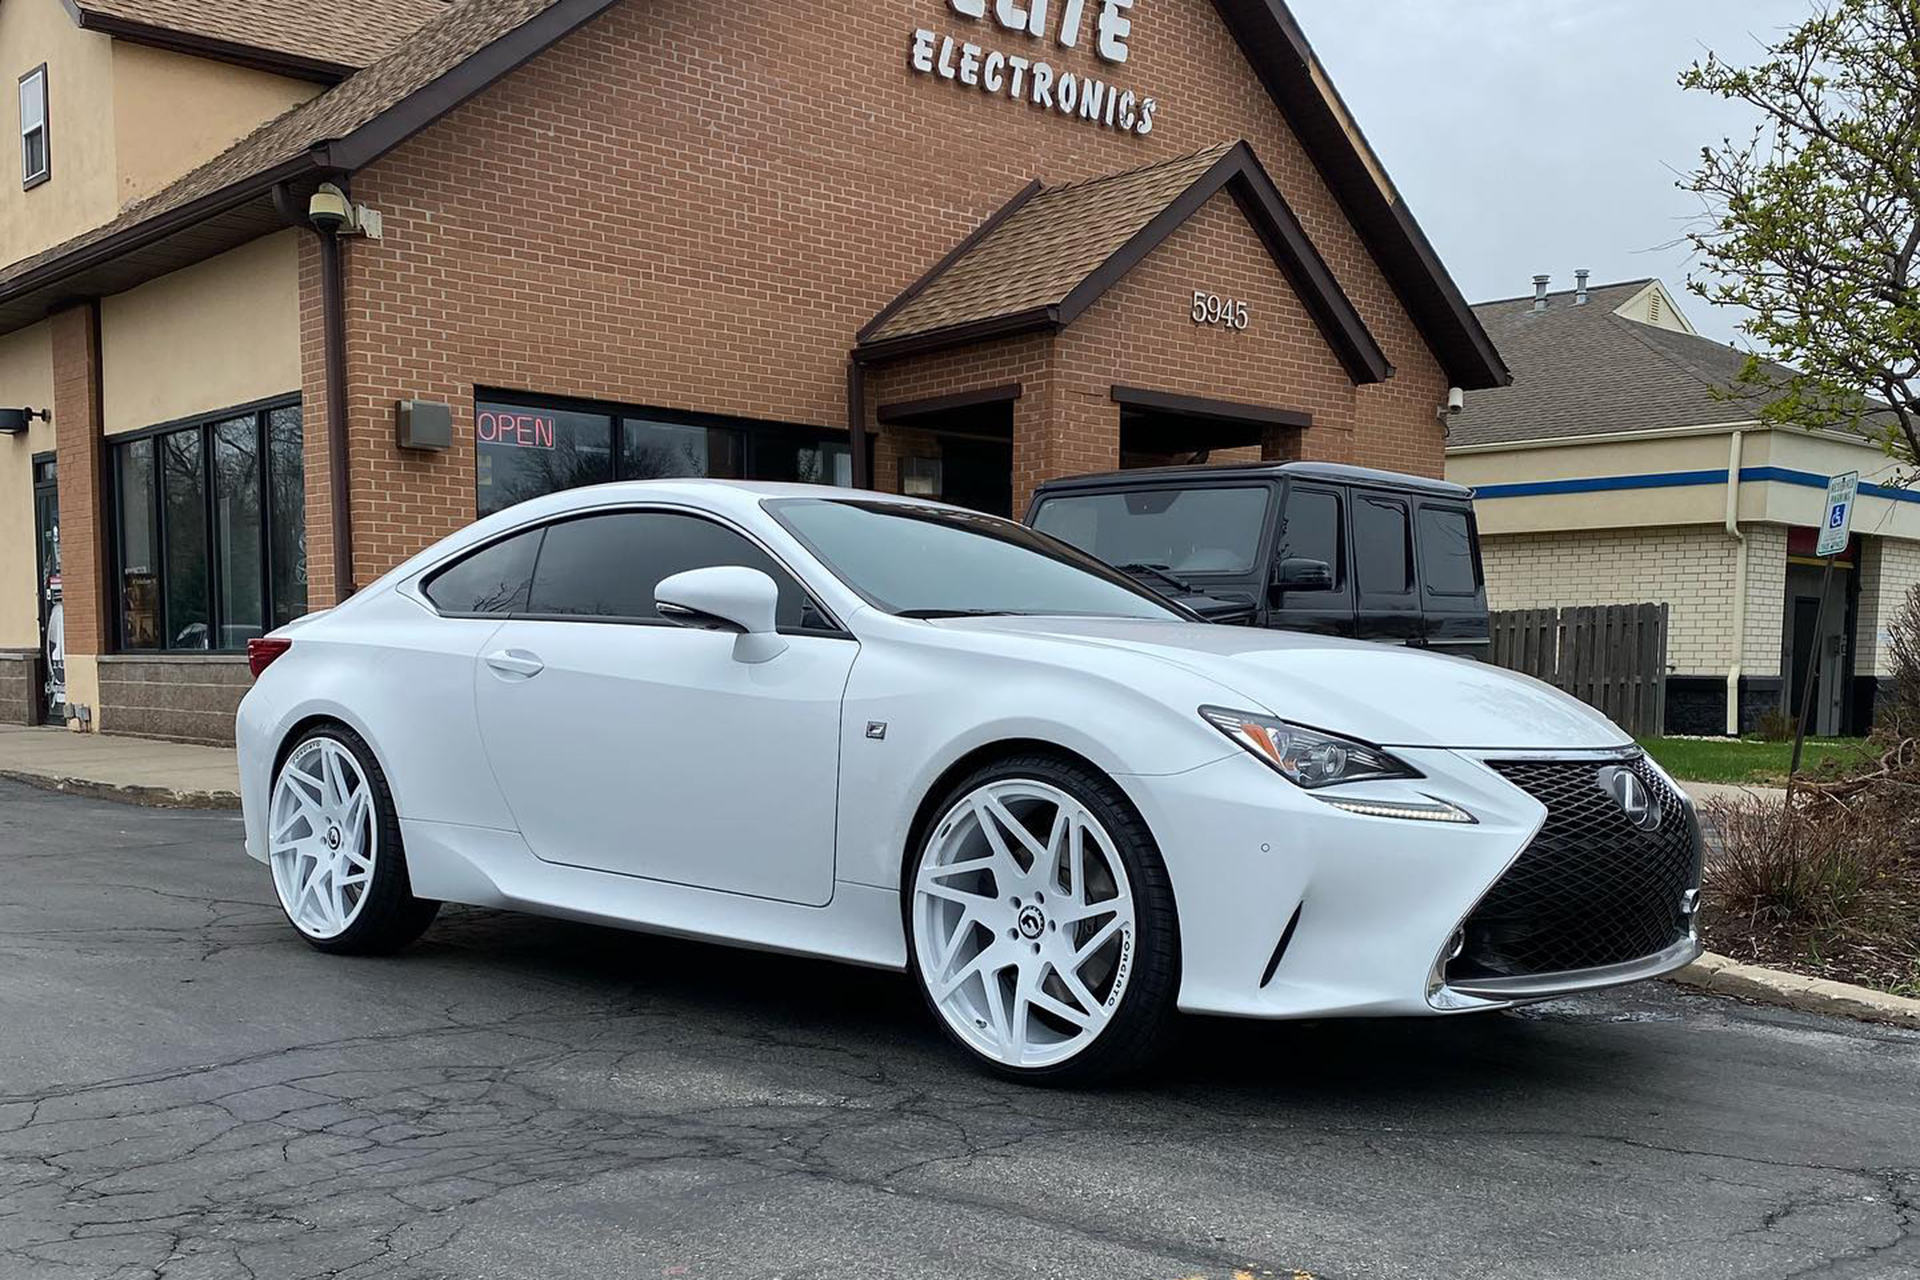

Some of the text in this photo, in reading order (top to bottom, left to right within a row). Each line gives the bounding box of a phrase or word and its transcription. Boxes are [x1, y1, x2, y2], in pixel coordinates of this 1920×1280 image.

[912, 28, 1157, 135] ELECTRONICS
[1192, 290, 1249, 330] 5945
[478, 412, 552, 447] OPEN
[1107, 929, 1132, 1007] FORGIATO
